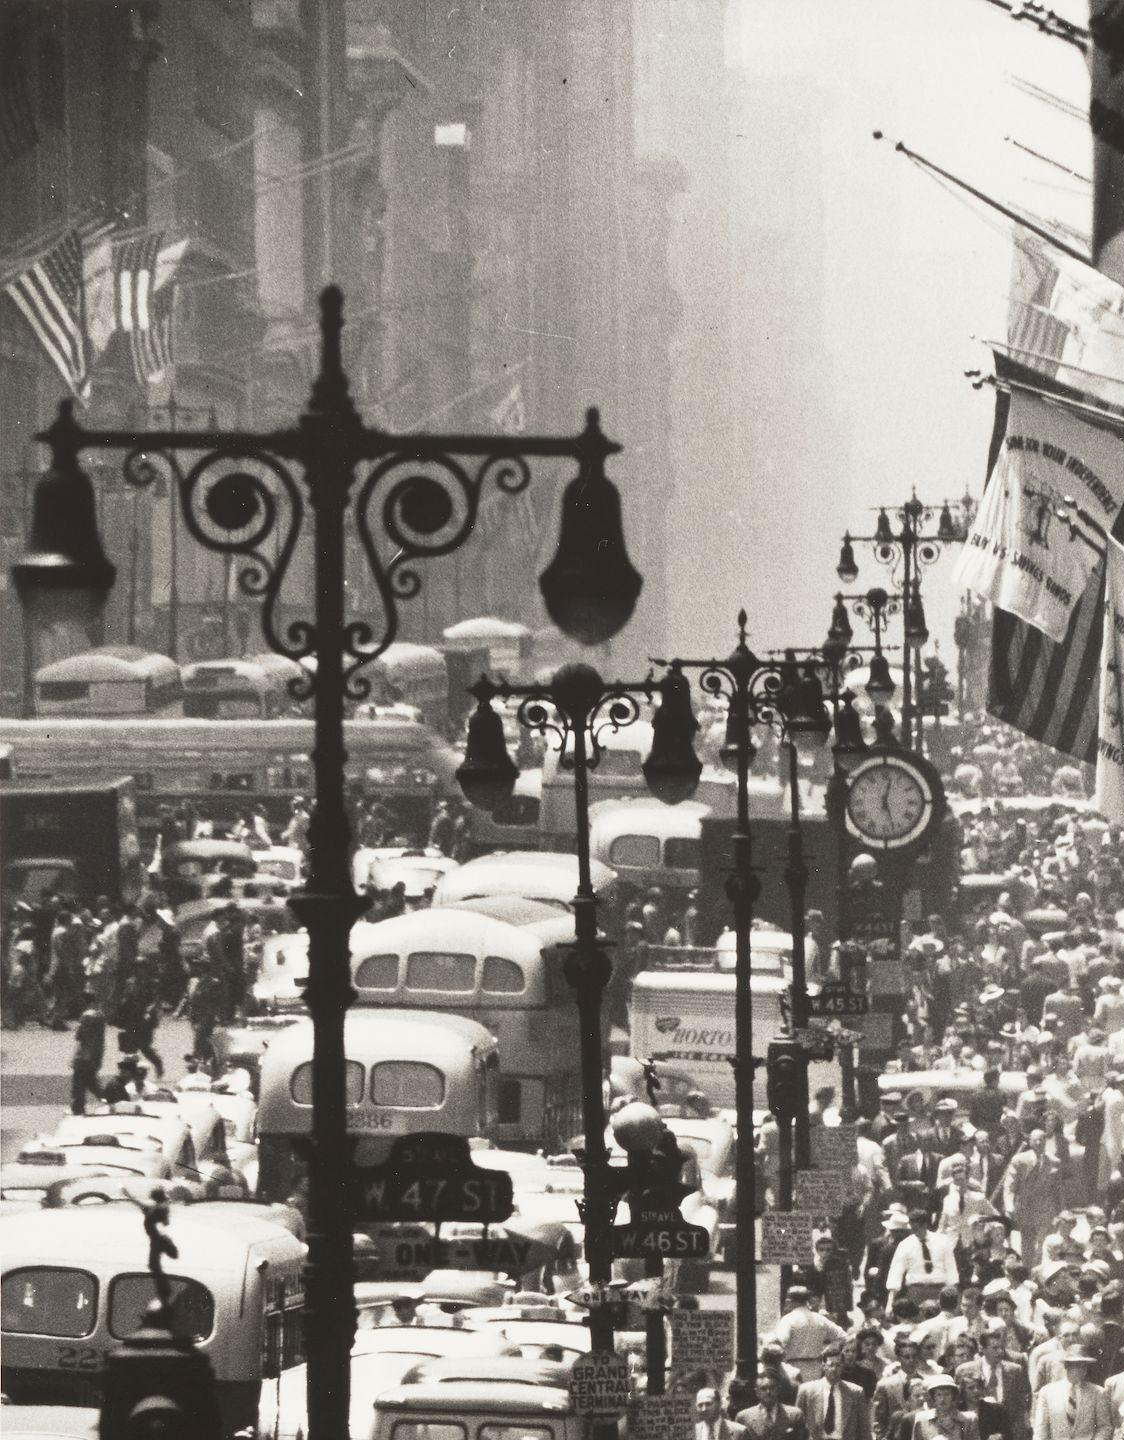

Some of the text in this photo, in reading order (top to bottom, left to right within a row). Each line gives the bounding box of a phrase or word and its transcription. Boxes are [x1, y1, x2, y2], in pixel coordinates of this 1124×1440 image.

[1042, 440, 1067, 466] YOUR
[1065, 454, 1118, 514] INDEPENDENCE
[825, 997, 846, 1012] 45
[673, 1029, 734, 1046] HORTO
[401, 1181, 448, 1211] 47
[641, 1230, 671, 1252] 46
[673, 1313, 687, 1321] NO
[58, 1346, 109, 1369] 22
[573, 1366, 628, 1381] GRAND
[569, 1380, 631, 1395] CENTRAL
